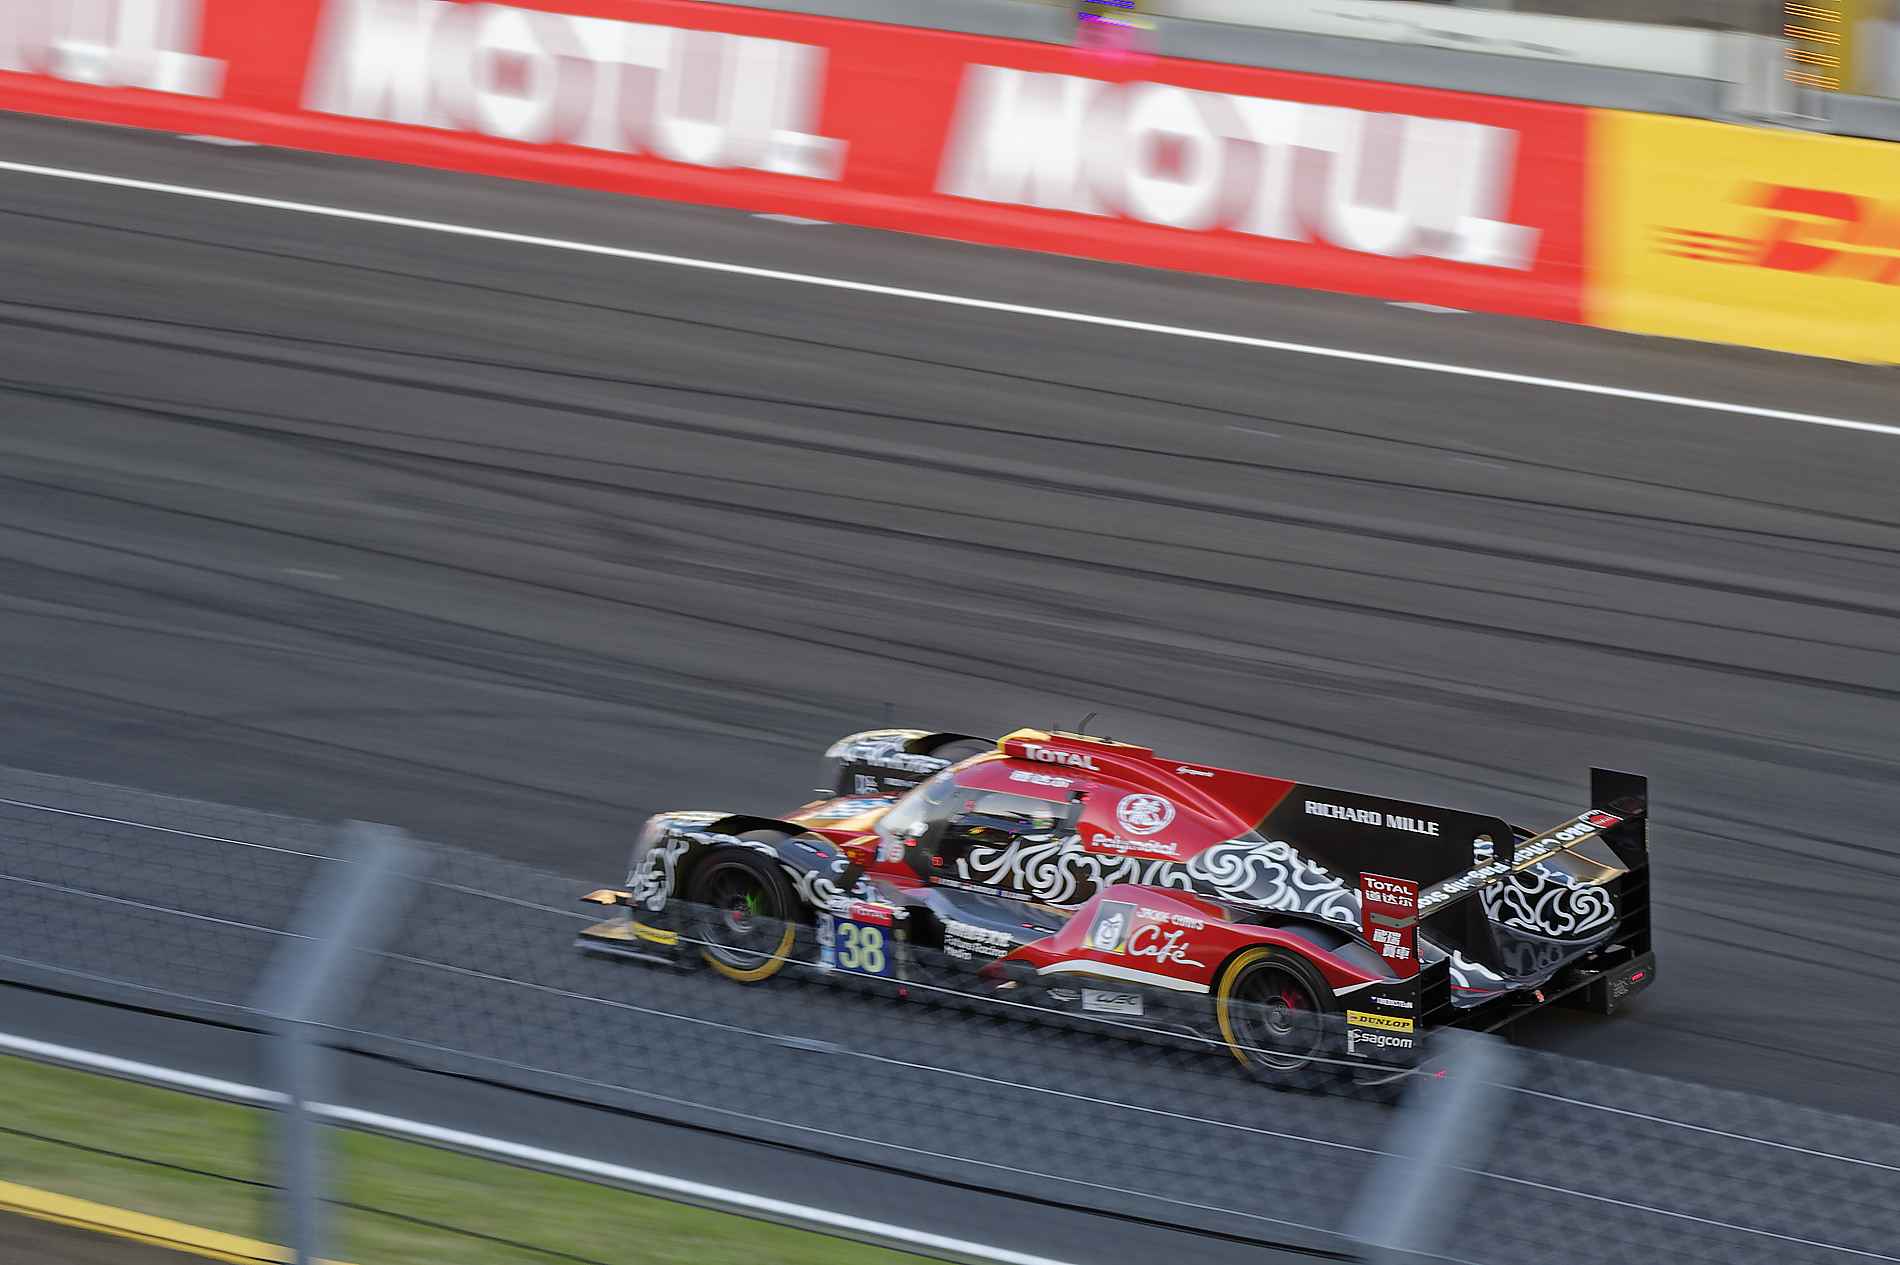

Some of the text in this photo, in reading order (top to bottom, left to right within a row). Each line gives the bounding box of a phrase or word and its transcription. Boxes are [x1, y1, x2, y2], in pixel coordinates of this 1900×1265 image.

[302, 0, 846, 181] MOTUL
[935, 62, 1541, 271] MOTUL
[1305, 800, 1440, 836] RICHARD MILLE
[1364, 877, 1414, 896] TOTAL
[837, 921, 886, 973] 38
[1359, 1015, 1411, 1029] DUNLOP
